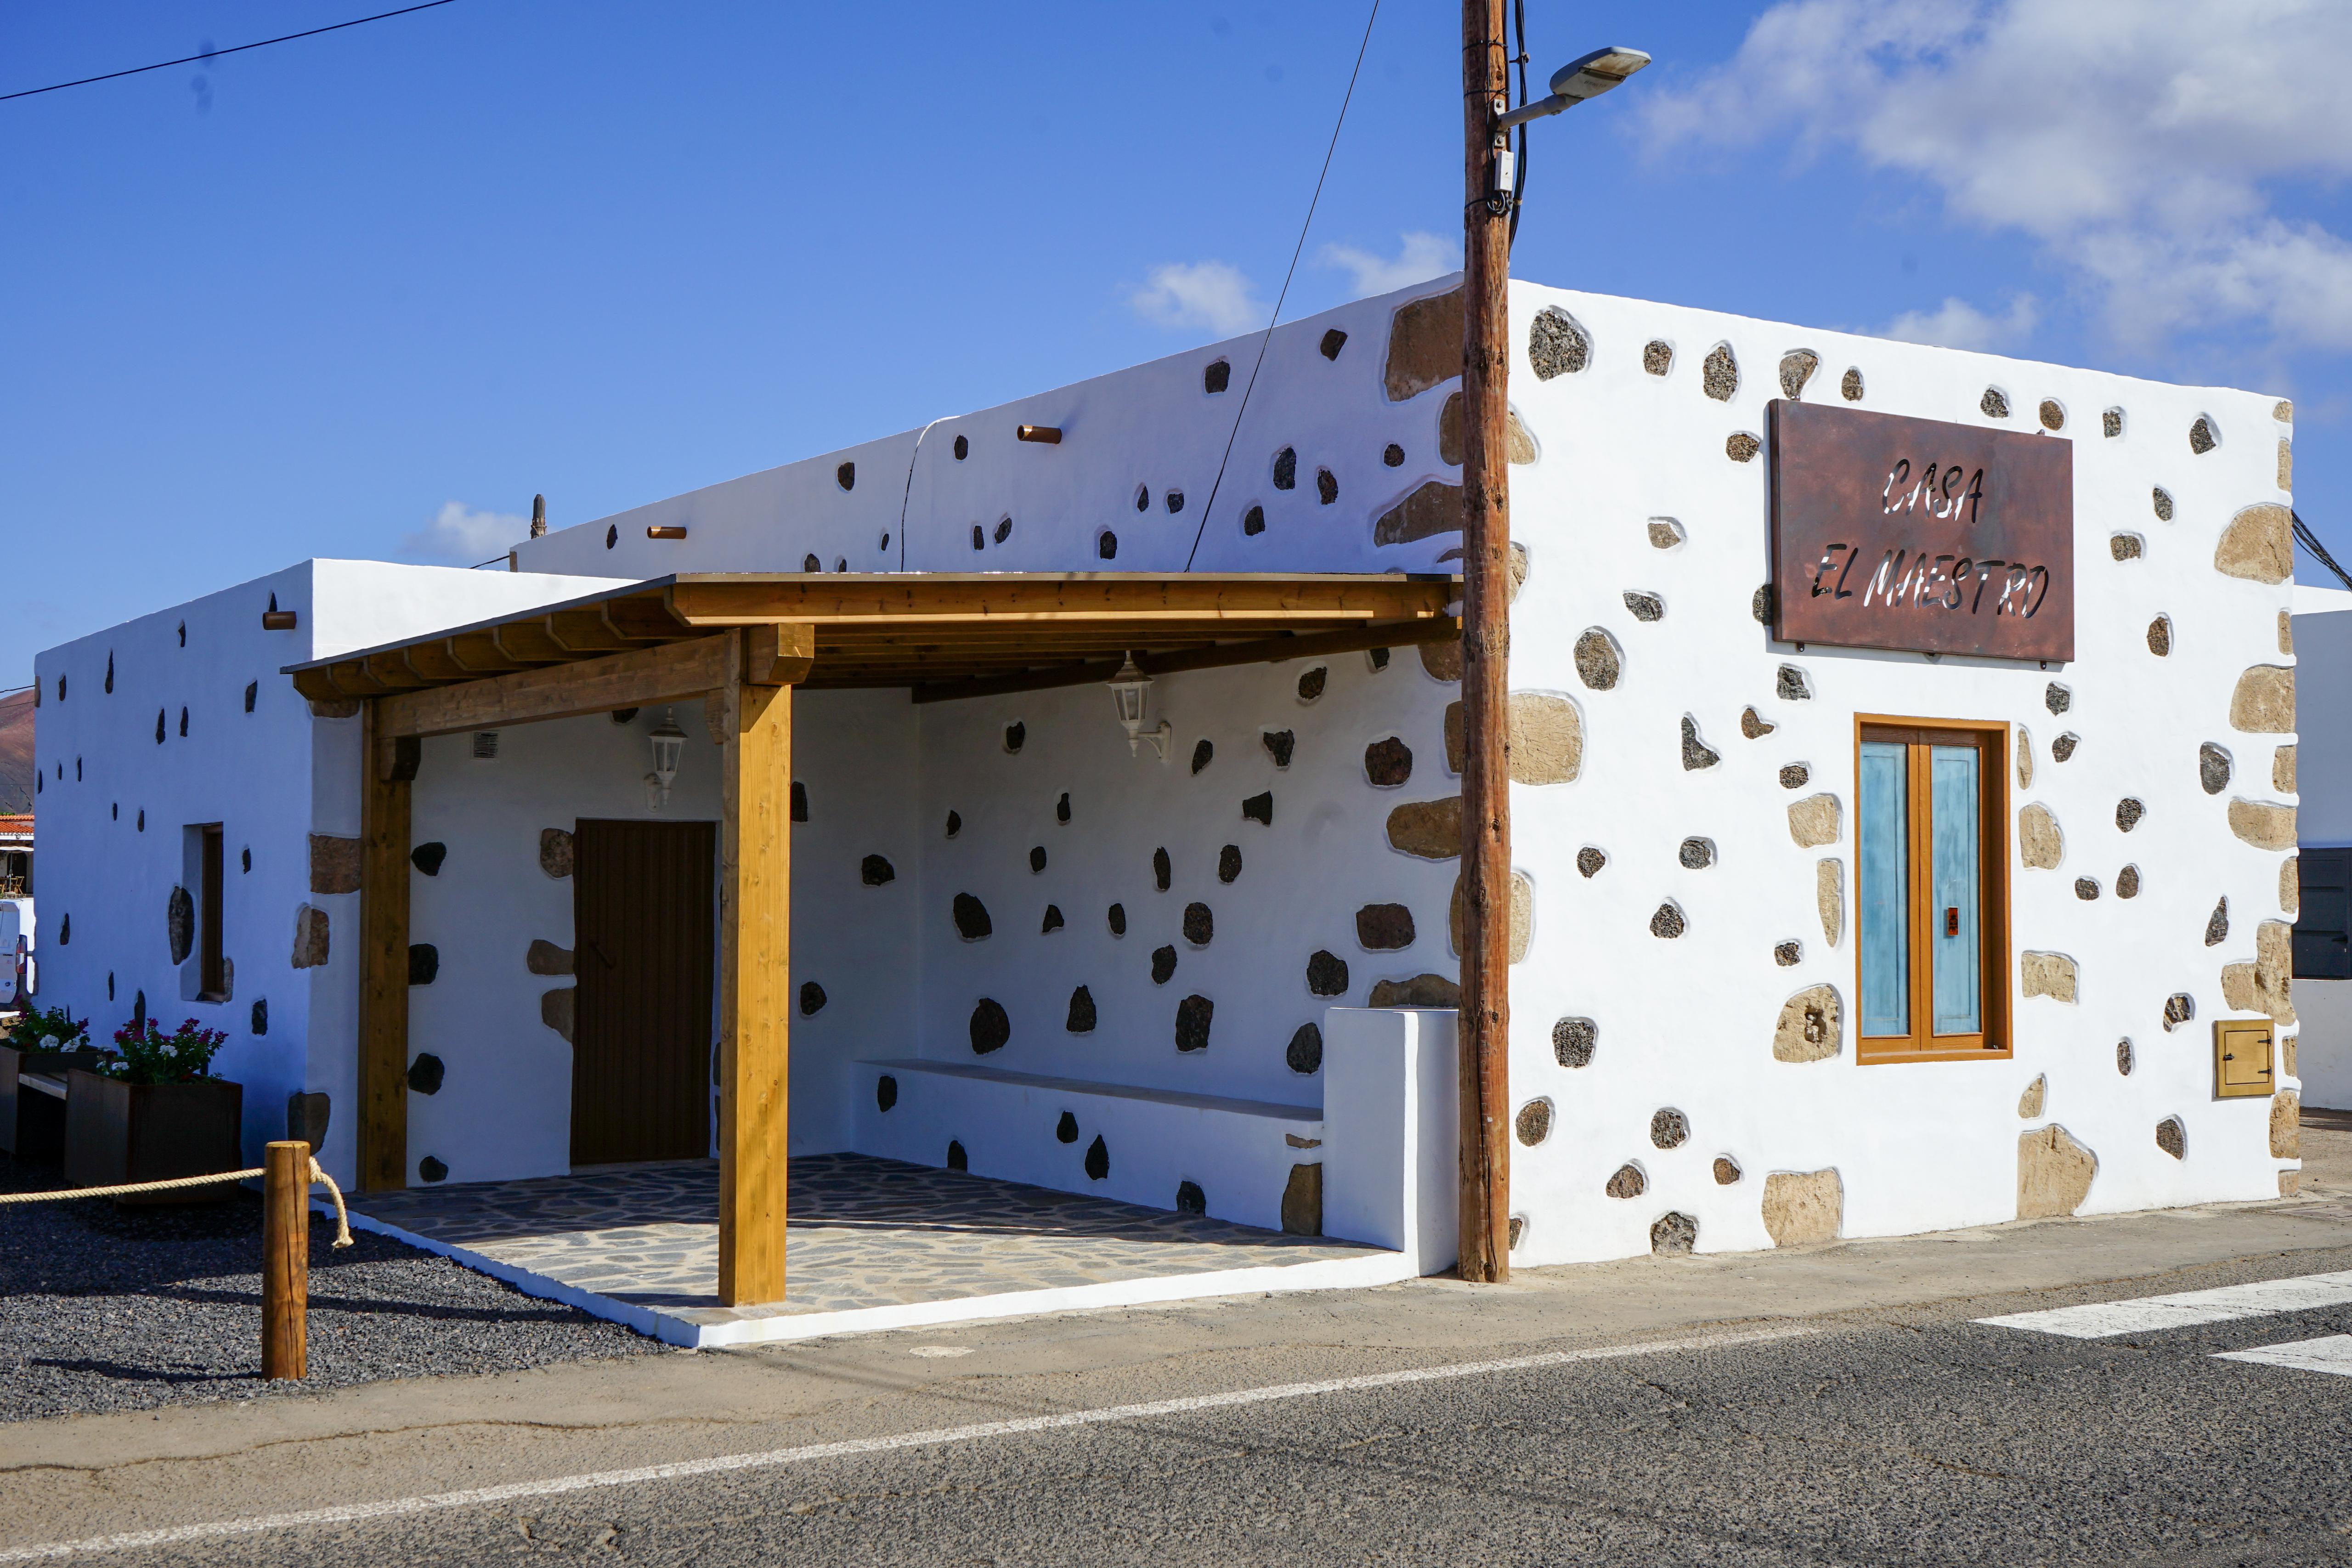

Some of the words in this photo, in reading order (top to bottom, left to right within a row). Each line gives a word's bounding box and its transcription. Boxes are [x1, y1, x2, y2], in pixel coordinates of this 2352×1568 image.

[1883, 459, 1983, 523] CASA
[1812, 543, 1859, 600] EL
[1864, 549, 2049, 618] MAESTRO
